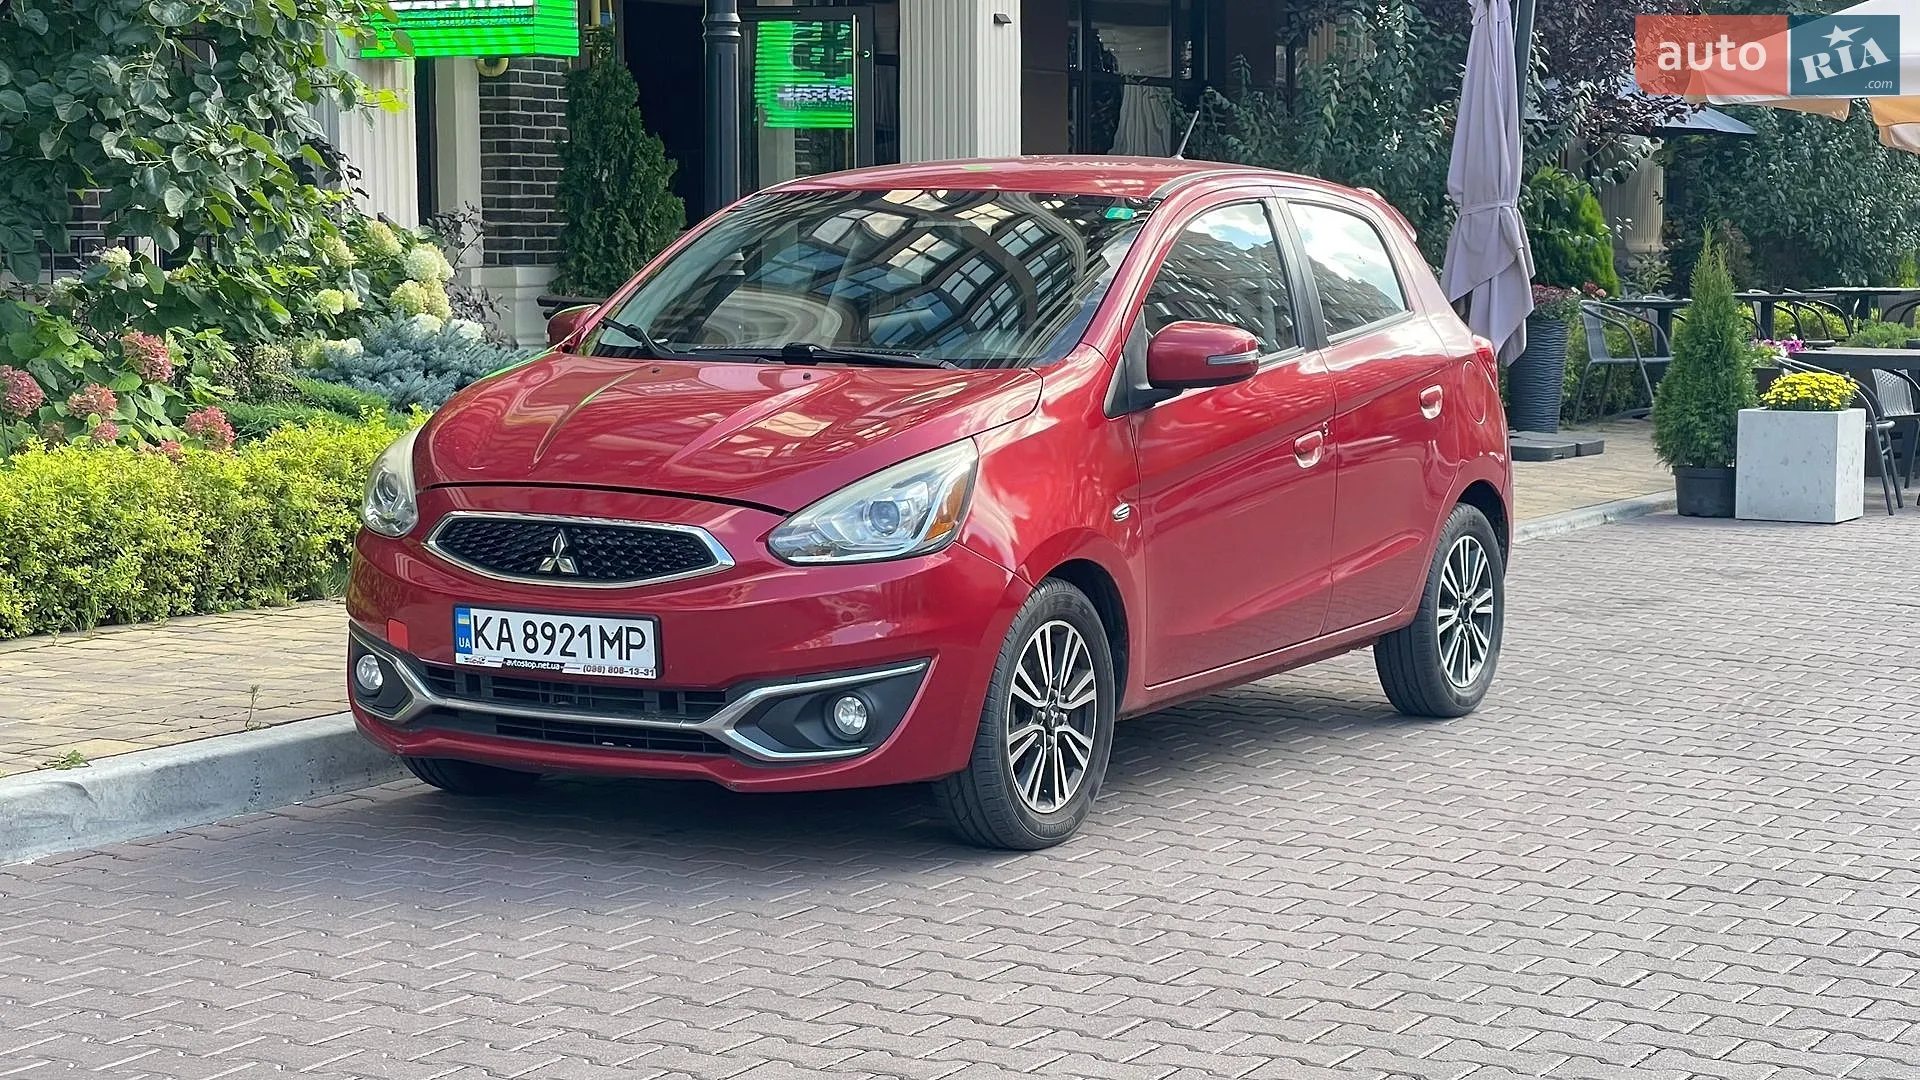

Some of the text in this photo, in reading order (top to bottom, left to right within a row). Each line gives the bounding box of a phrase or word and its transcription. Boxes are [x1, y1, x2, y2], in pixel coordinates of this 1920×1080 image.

[458, 636, 471, 649] UA
[473, 614, 647, 662] KA 8921 MP
